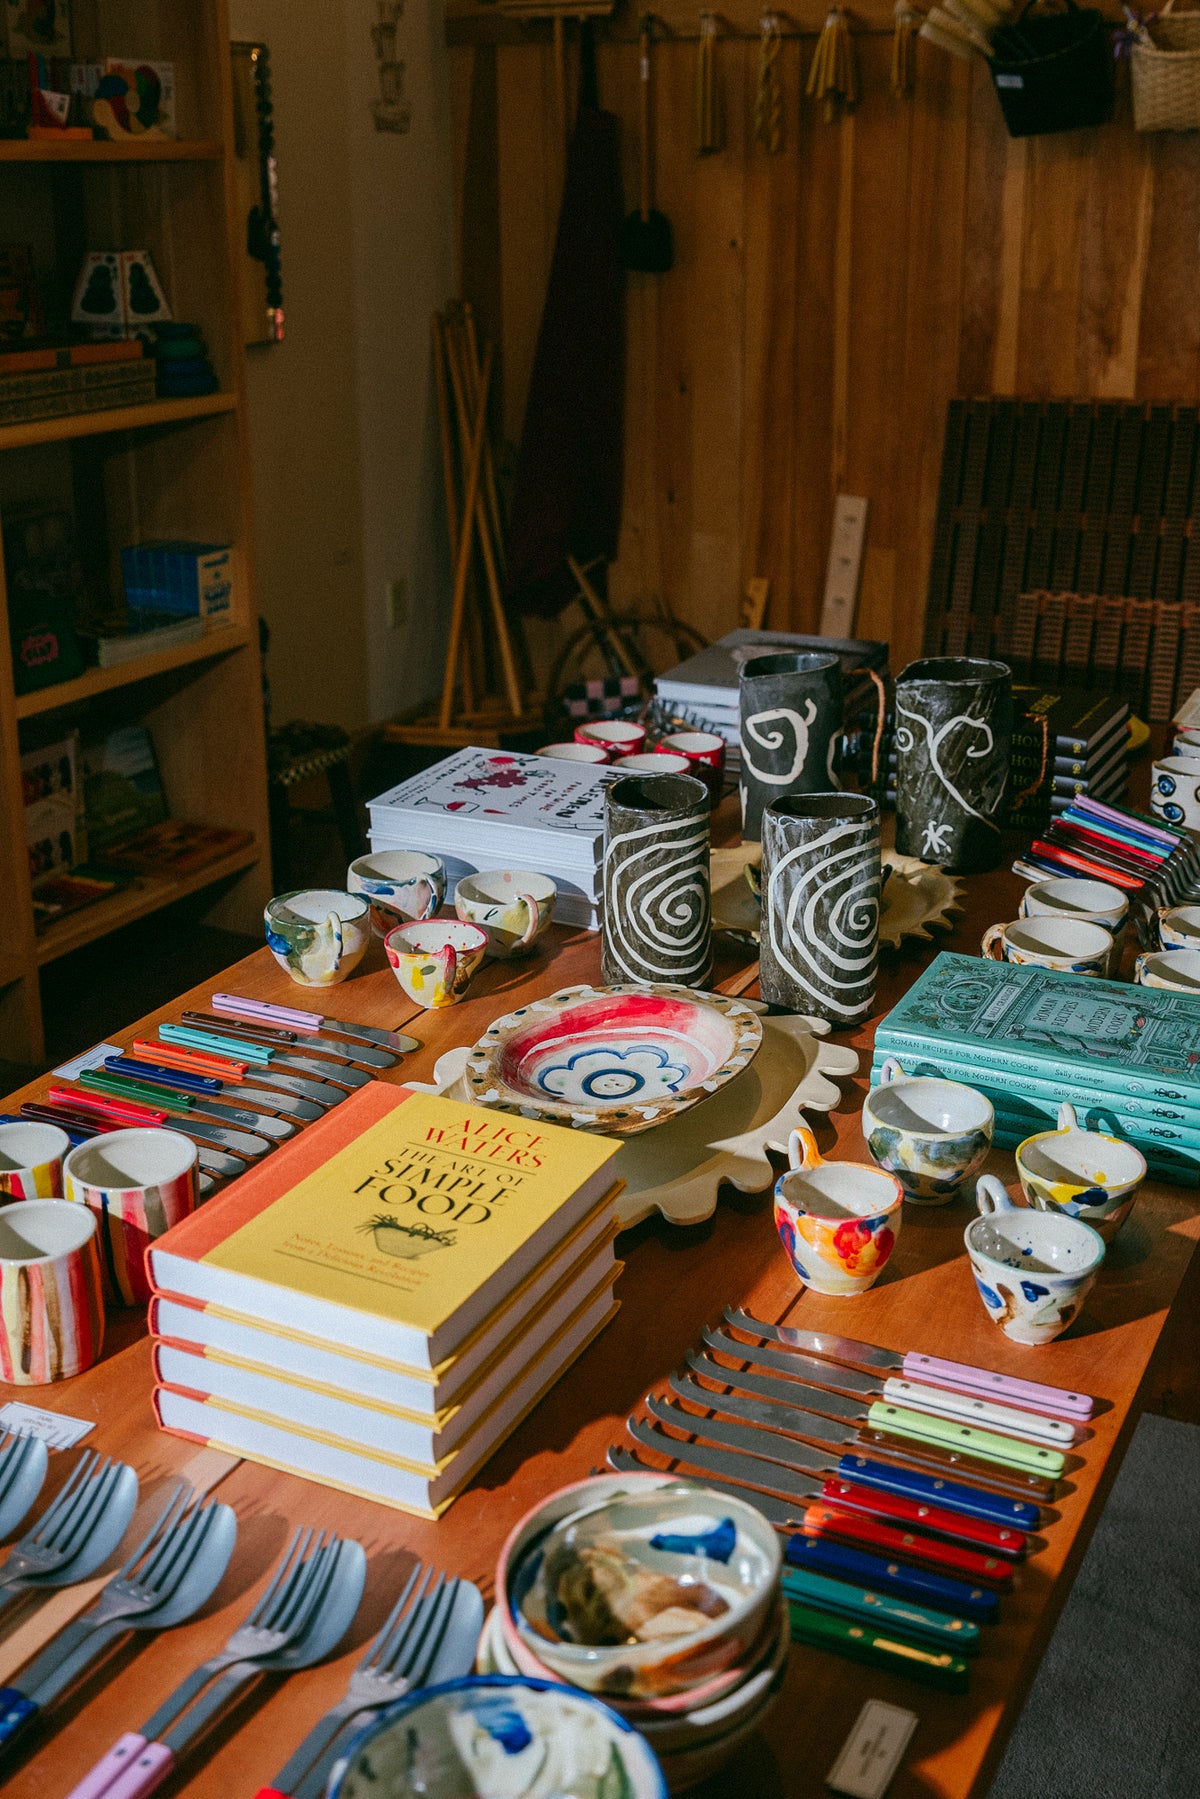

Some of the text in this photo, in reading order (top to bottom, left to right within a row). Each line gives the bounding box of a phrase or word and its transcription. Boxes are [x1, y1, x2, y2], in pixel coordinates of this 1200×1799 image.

[1032, 997, 1059, 1022] ROMAN
[1051, 1000, 1079, 1027] RECIPES
[1084, 1005, 1112, 1035] MODERN
[1105, 1012, 1128, 1035] COOKS
[890, 1037, 1039, 1073] ROMAN RECIPES FOR MODERN COOKS
[954, 1068, 969, 1078] FOR
[972, 1072, 1008, 1085] MODERN
[1009, 1080, 1038, 1092] COOKS
[1054, 1068, 1105, 1085] Sally Grainger
[1052, 1087, 1103, 1105] Sally Grainger
[425, 1127, 547, 1168] WATERS
[448, 1119, 549, 1149] ALICE
[374, 1159, 518, 1206] SIMPLE
[397, 1148, 528, 1187] THE ART OF
[353, 1175, 492, 1225] FOOD
